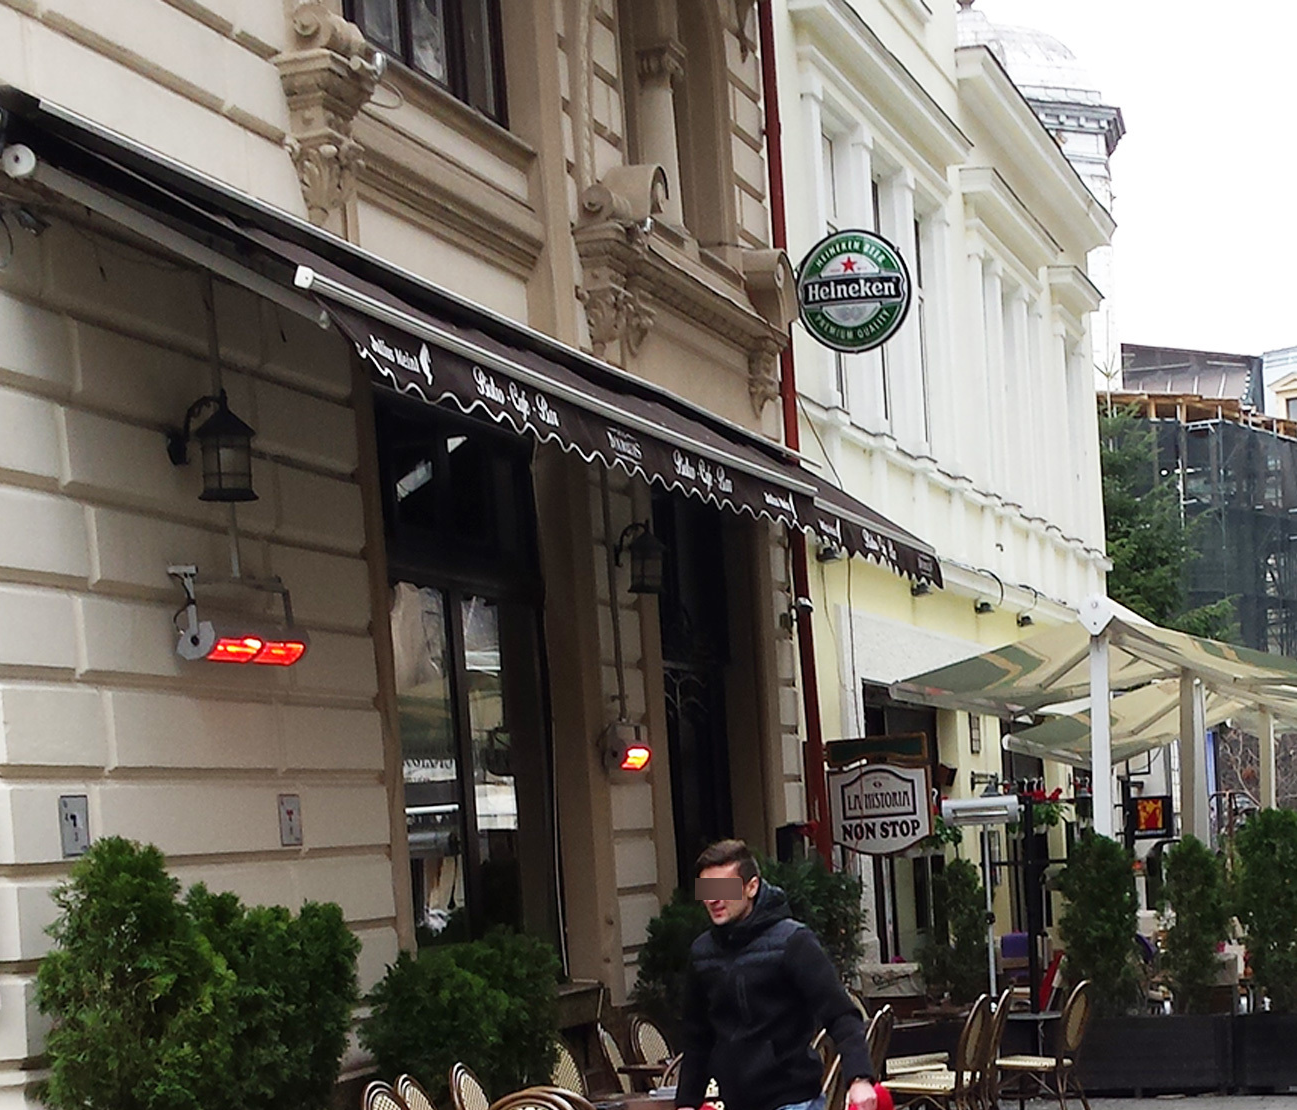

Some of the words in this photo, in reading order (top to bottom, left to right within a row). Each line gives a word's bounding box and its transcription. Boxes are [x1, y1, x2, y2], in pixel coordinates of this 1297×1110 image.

[815, 240, 860, 268] HEINEKEN
[863, 243, 887, 263] BEER
[807, 279, 897, 302] Heineken
[857, 309, 891, 338] QUALITY
[847, 795, 862, 811] LA
[864, 791, 911, 810] HISTORIA
[842, 822, 876, 841] NON
[880, 820, 921, 839] STOP
